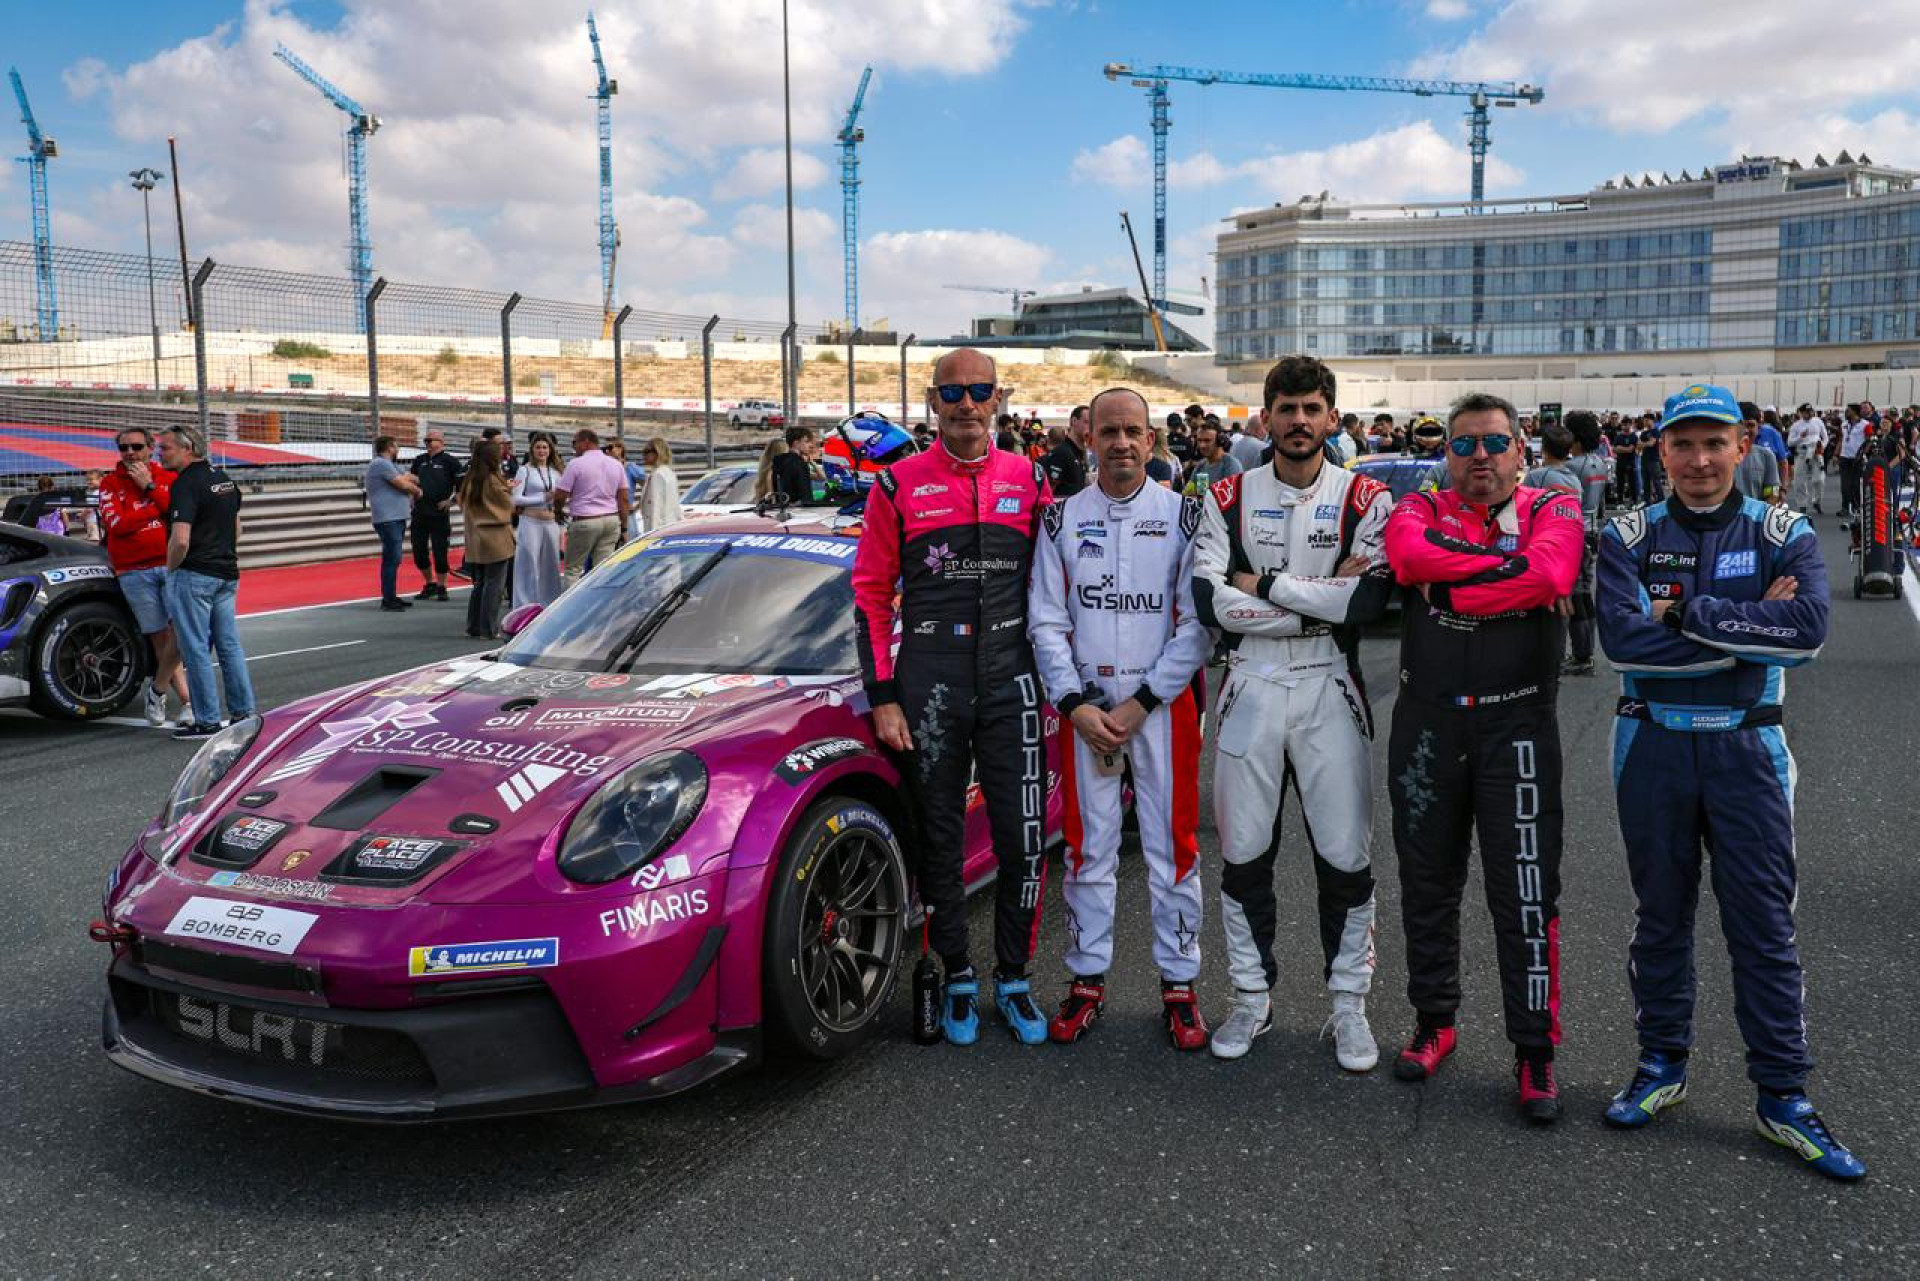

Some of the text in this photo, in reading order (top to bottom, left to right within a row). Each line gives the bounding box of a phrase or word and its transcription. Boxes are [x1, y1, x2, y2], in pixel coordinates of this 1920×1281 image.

[731, 535, 784, 548] 24H
[779, 537, 859, 559] DUBAI
[1718, 552, 1756, 569] 24H
[1103, 593, 1164, 610] SIMU
[549, 706, 683, 721] MAGNITUDE
[356, 729, 616, 777] SP Consulting
[1014, 671, 1043, 909] PORSCHE
[1511, 739, 1550, 1013] PORSCHE
[600, 889, 709, 937] FINARIS
[181, 918, 283, 947] BOMBERG
[455, 946, 547, 965] MICHELIN
